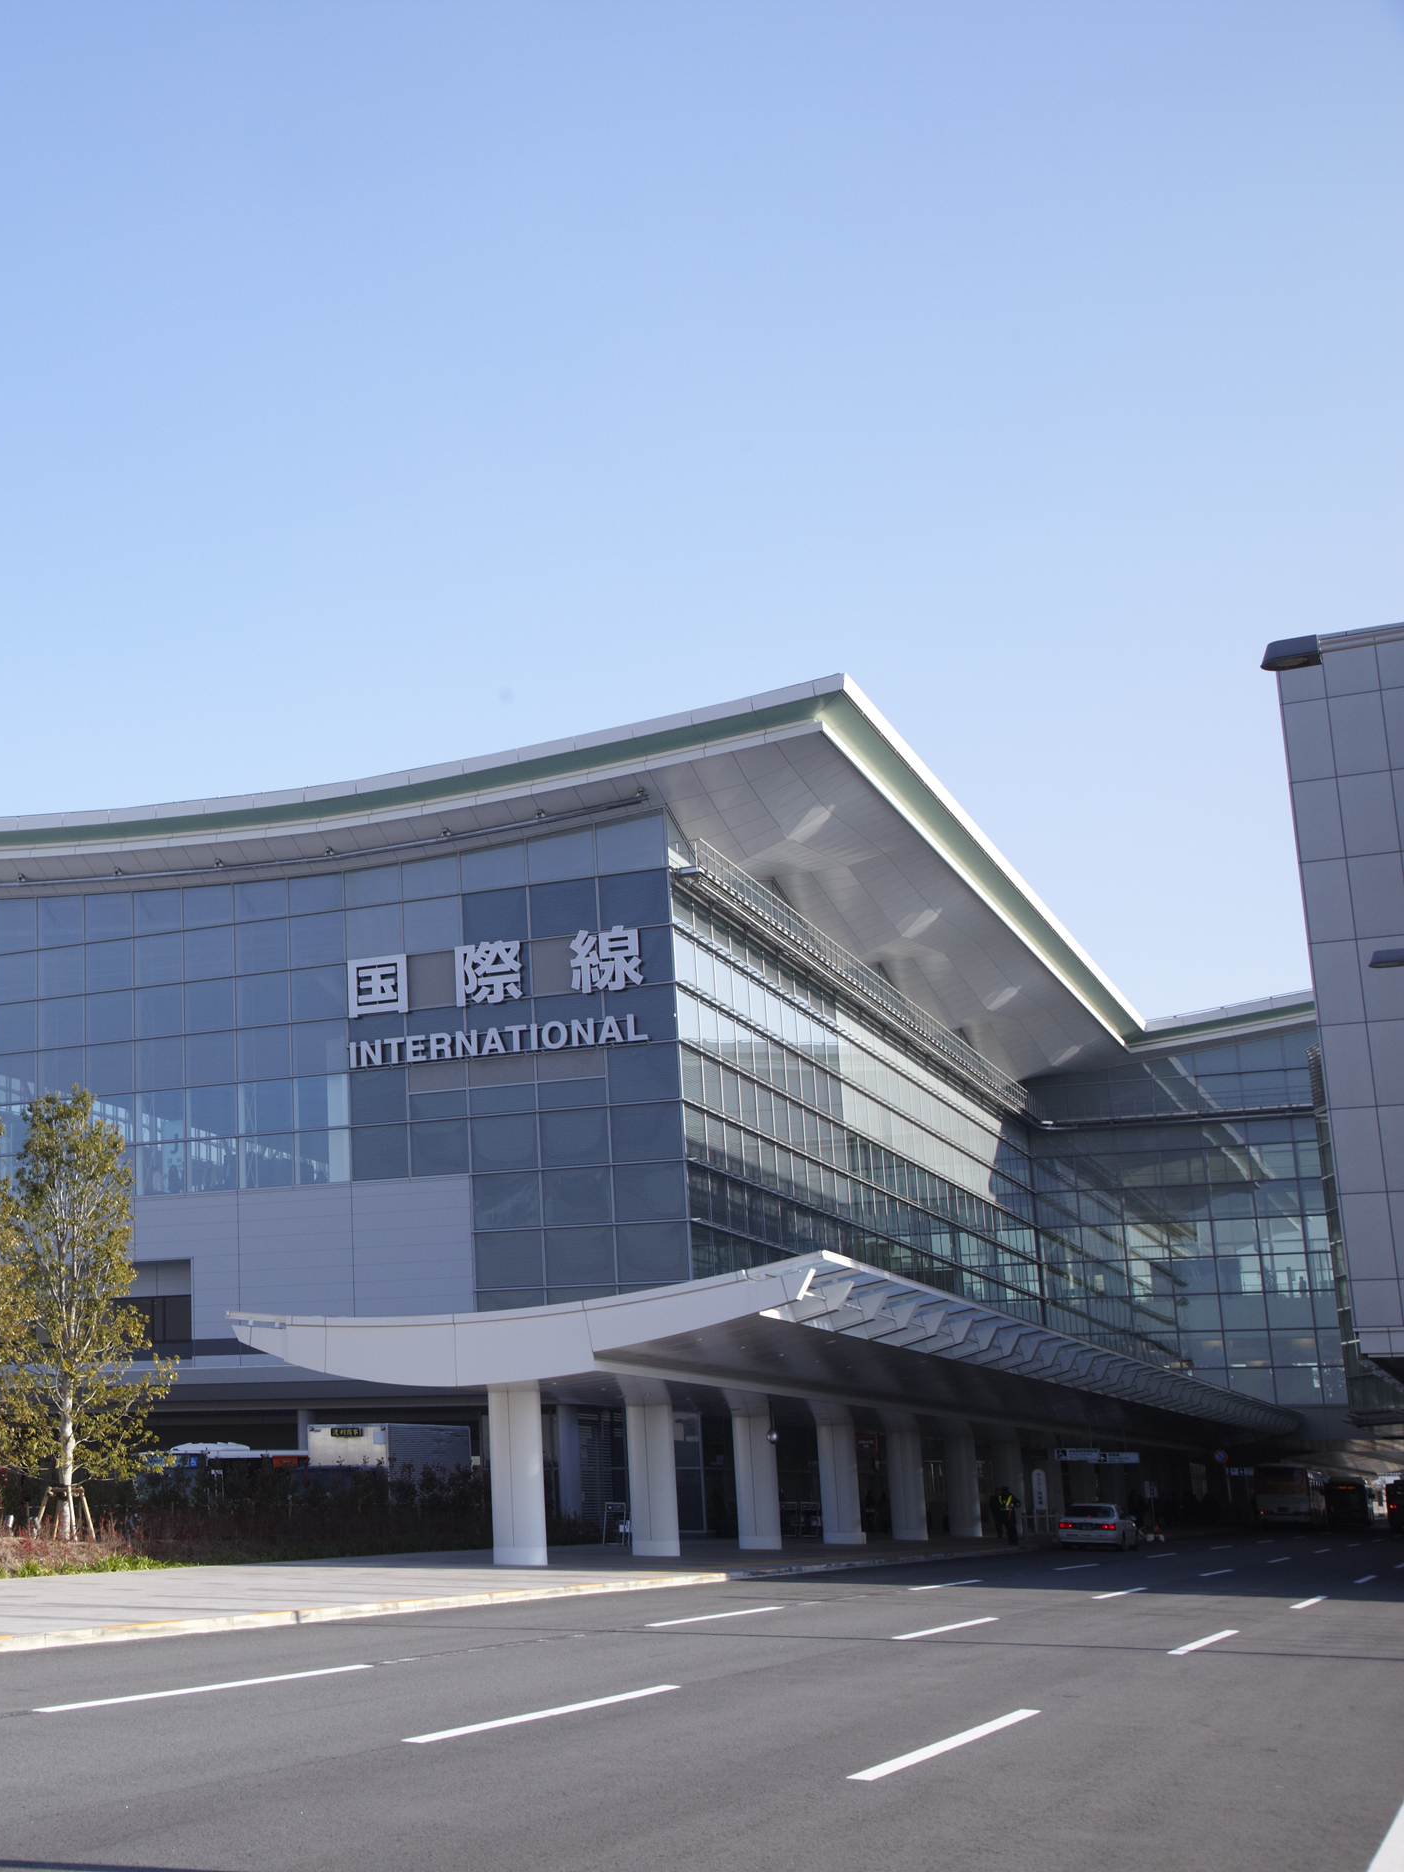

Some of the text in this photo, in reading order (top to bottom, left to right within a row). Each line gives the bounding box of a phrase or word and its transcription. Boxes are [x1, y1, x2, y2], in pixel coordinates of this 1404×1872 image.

[347, 925, 644, 1019] 国際線
[349, 1013, 649, 1069] INTERNATIONAL
